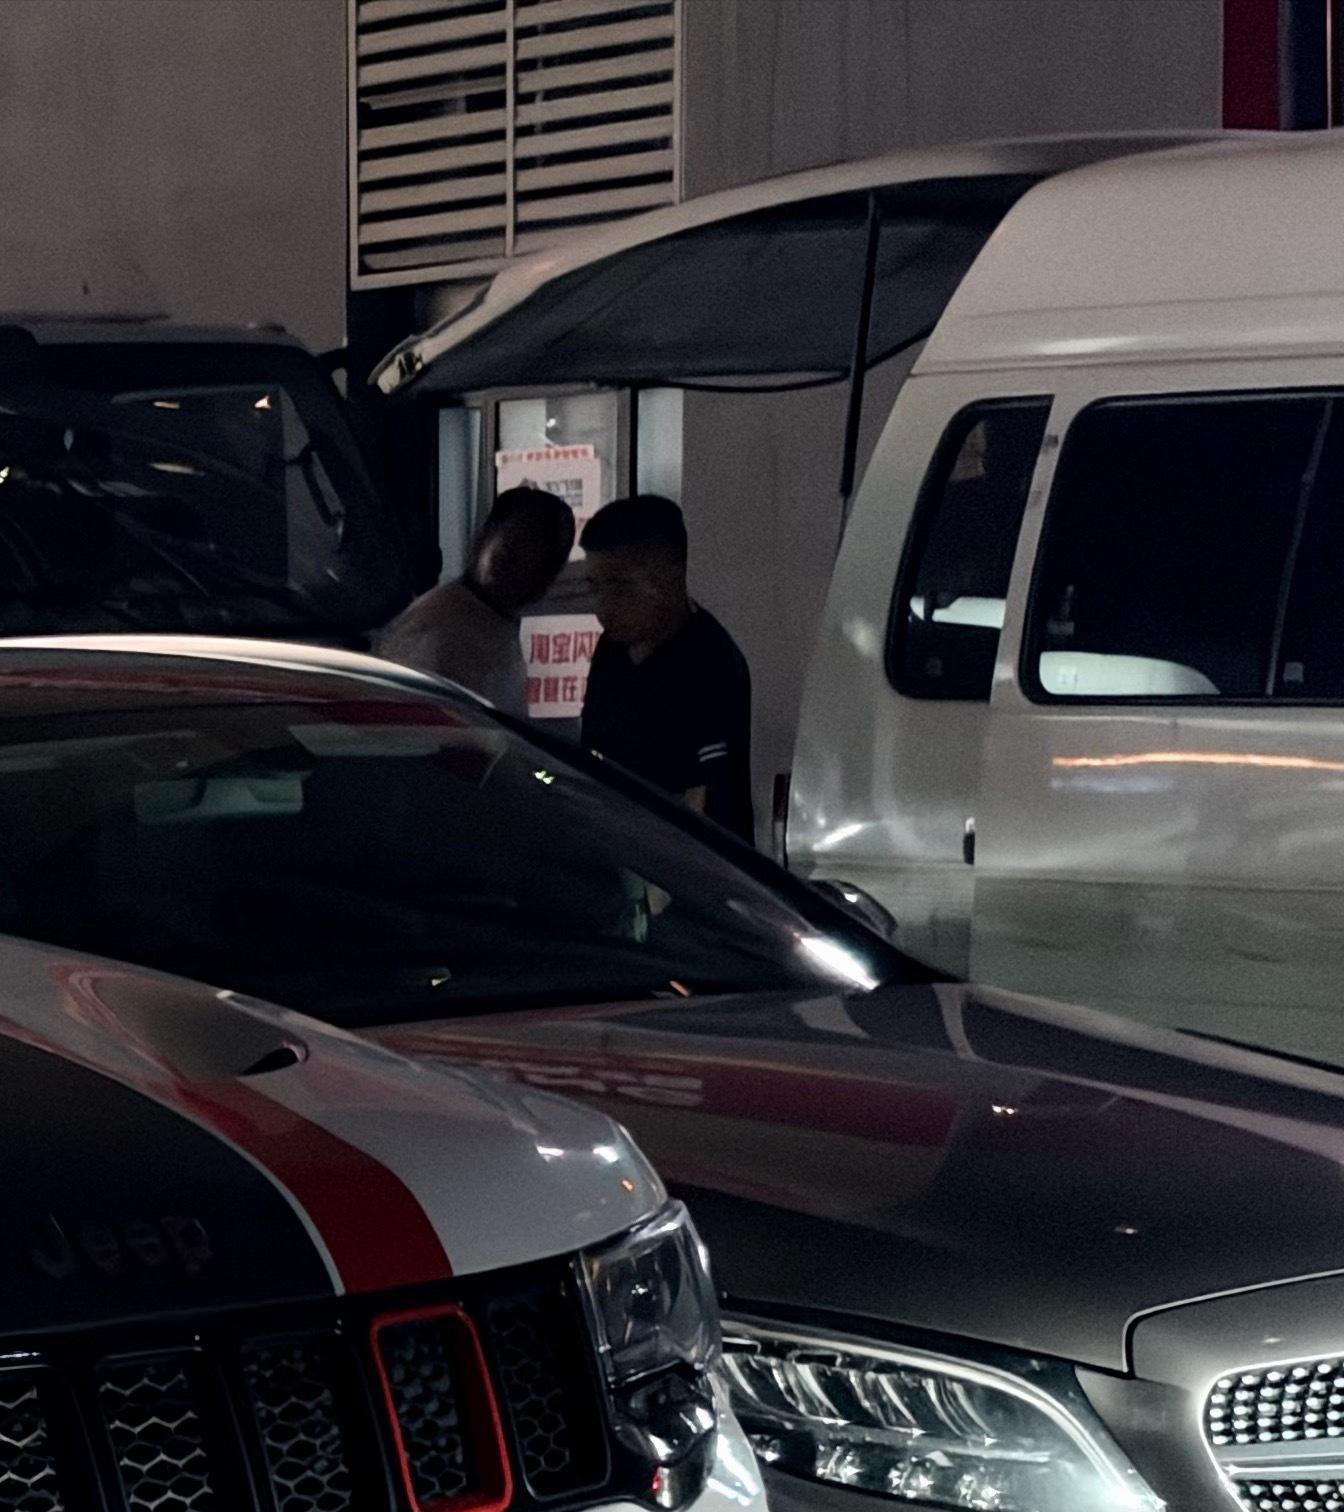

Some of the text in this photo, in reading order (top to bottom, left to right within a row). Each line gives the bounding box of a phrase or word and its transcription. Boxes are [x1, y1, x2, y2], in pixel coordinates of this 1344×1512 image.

[529, 630, 600, 665] 淘宝闪
[29, 1212, 212, 1279] Jeep
